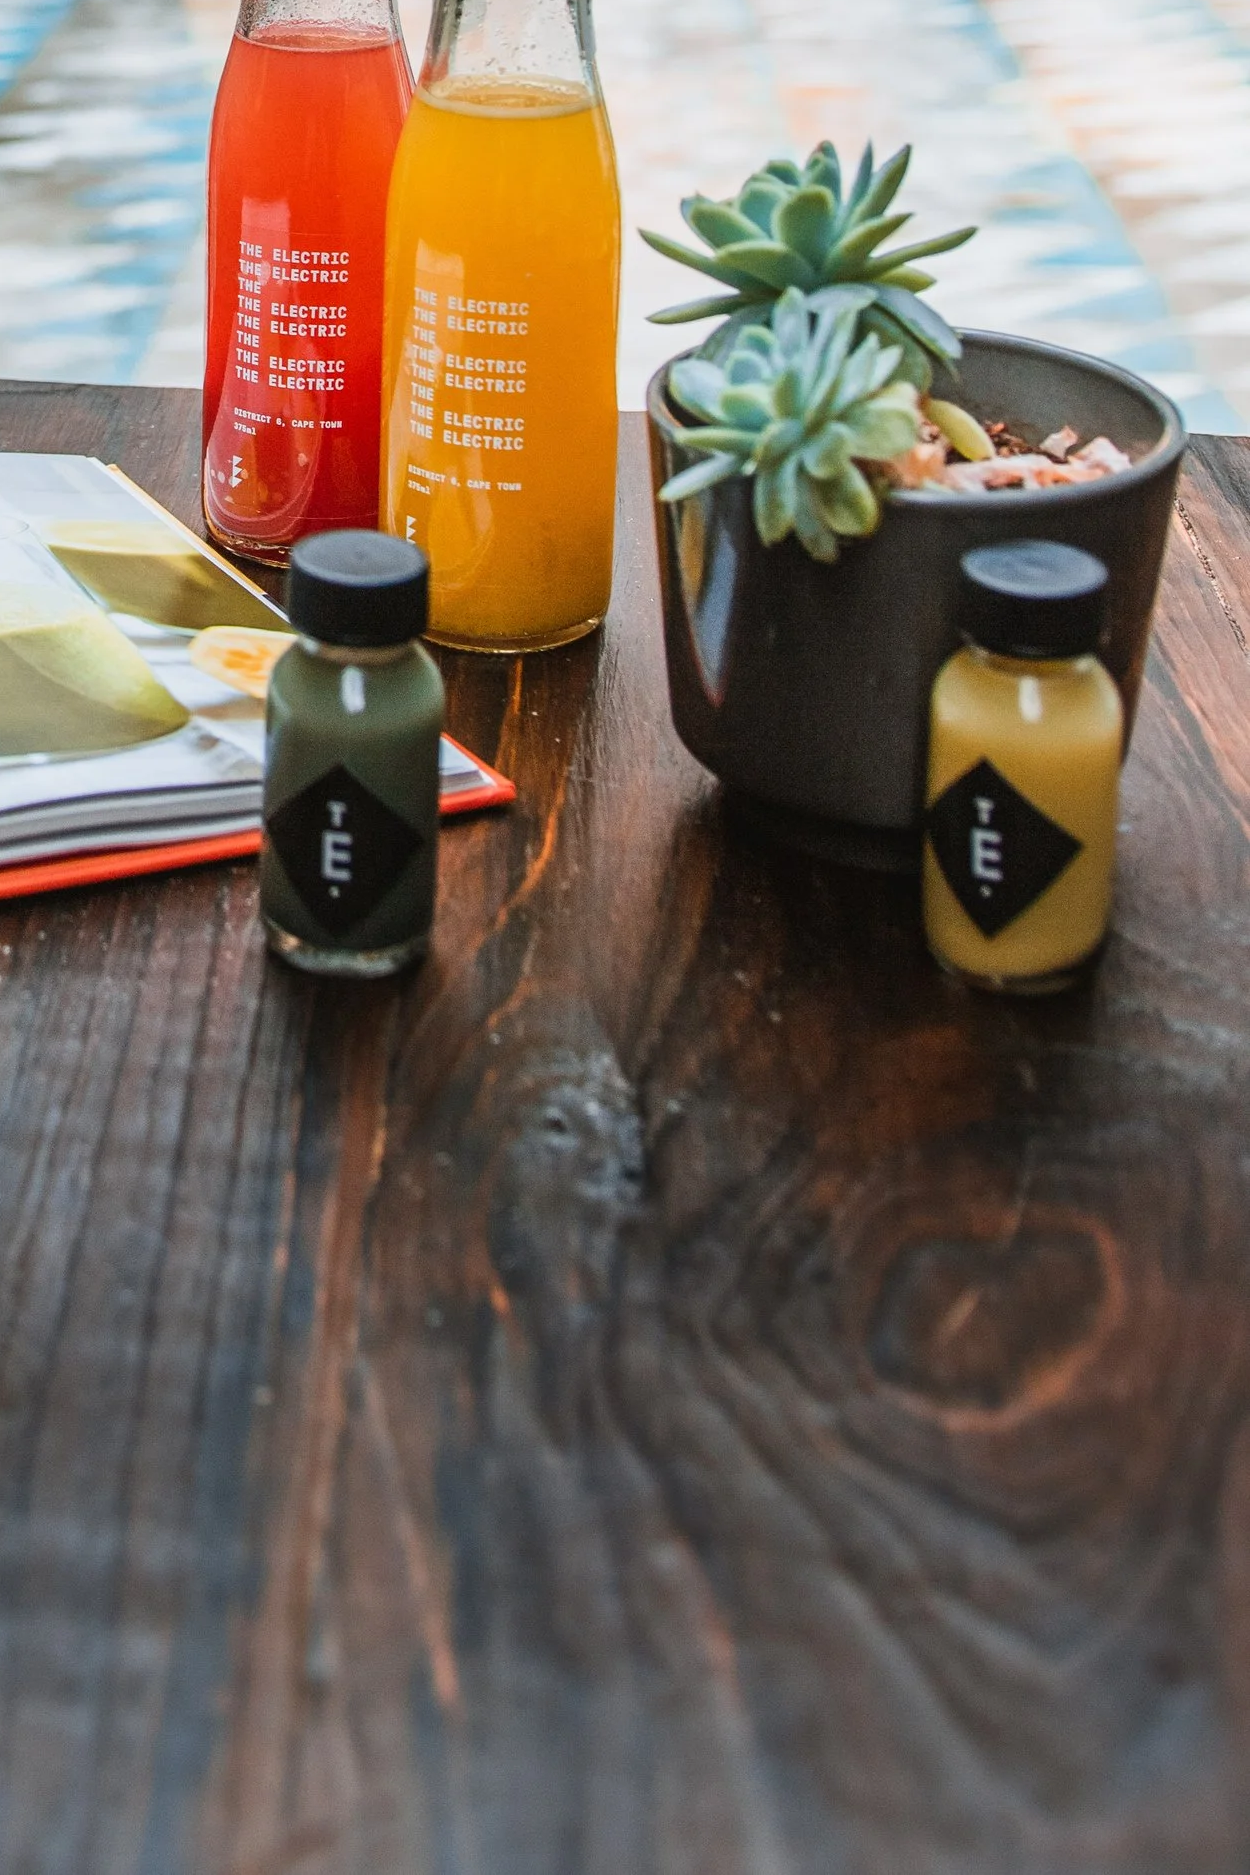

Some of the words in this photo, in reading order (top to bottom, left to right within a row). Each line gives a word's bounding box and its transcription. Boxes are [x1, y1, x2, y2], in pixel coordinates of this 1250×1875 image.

[239, 241, 262, 258] THE
[273, 249, 349, 265] ELECTRIC
[238, 259, 262, 276] THE
[272, 267, 348, 283] ELECTRIC
[238, 277, 261, 294] THE
[238, 295, 260, 312] THE
[271, 303, 347, 319] ELECTRIC
[414, 287, 437, 306] THE
[447, 295, 529, 315] ELECTRIC
[237, 313, 260, 330] THE
[270, 321, 346, 337] ELECTRIC
[414, 306, 437, 325] THE
[447, 315, 528, 335] ELECTRIC
[236, 330, 259, 347] THE
[413, 325, 436, 344] THE
[236, 348, 259, 365] THE
[270, 356, 345, 373] ELECTRIC
[412, 344, 435, 363] THE
[446, 353, 527, 374] ELECTRIC
[235, 365, 258, 383] THE
[268, 374, 344, 391] ELECTRIC
[412, 363, 435, 382] THE
[445, 373, 526, 393] ELECTRIC
[411, 381, 434, 401] THE
[234, 407, 271, 423] DISTRICT
[292, 420, 314, 428] CAPE
[411, 401, 433, 420] THE
[444, 410, 525, 431] ELECTRIC
[410, 419, 433, 439] THE
[443, 429, 524, 451] ELECTRIC
[497, 481, 522, 491] TOWN
